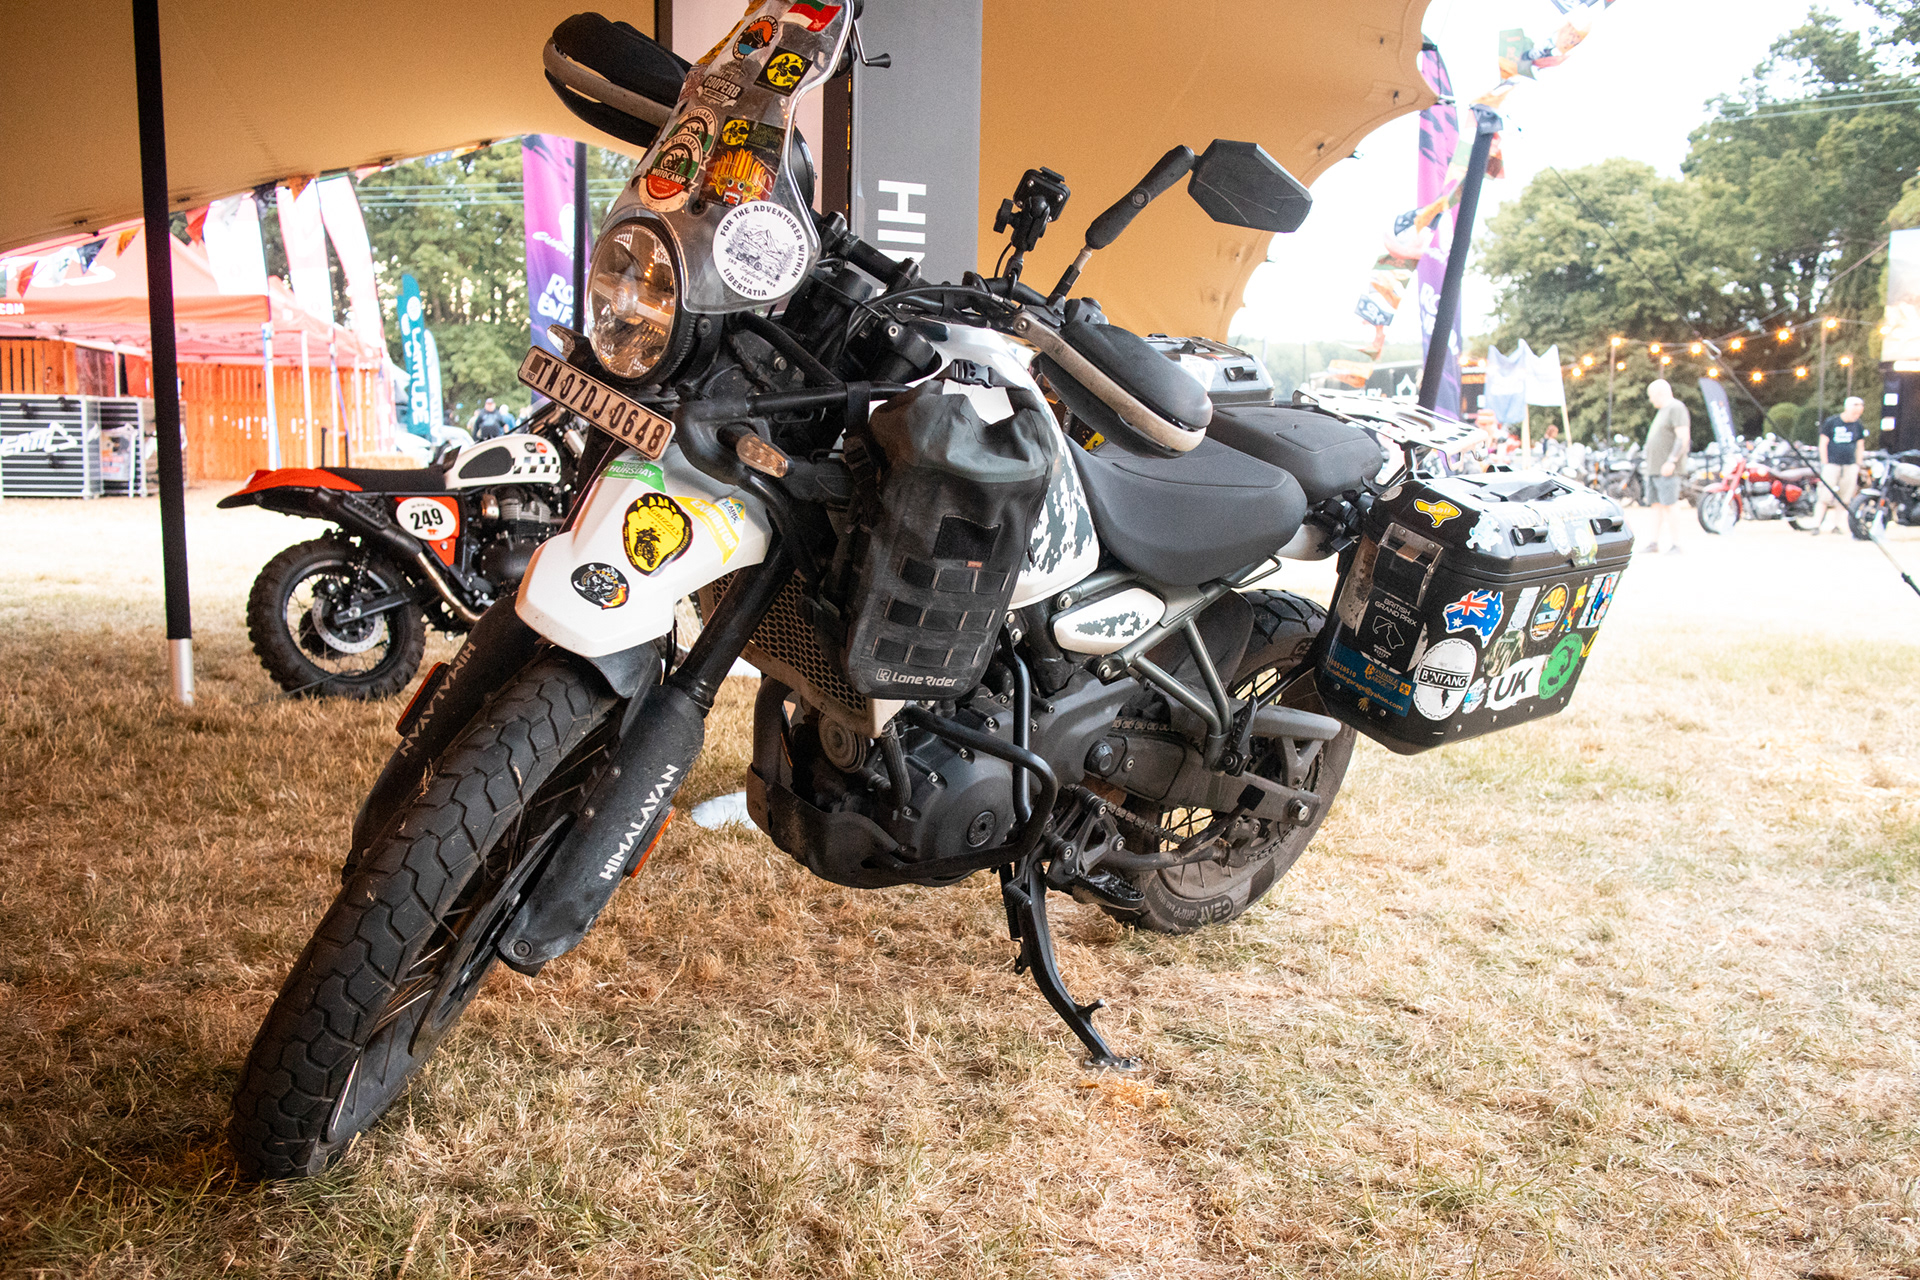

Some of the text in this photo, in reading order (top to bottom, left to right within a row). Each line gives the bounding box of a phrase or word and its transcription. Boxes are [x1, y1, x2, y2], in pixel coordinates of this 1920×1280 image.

[651, 167, 687, 185] MOTOCAMP
[720, 205, 805, 278] FOR THE ADVENTURER WITHIN
[723, 268, 768, 297] LIBERTATIA
[525, 372, 535, 381] IND
[605, 464, 656, 479] HURSDAY
[410, 507, 444, 531] 249
[650, 508, 683, 537] GRIZZLY
[691, 499, 737, 550] EXHIBITOR
[1374, 601, 1417, 627] GRAND PRIX
[1383, 598, 1411, 616] BRITISH
[892, 672, 923, 684] Lone
[925, 676, 958, 687] Rider
[1421, 669, 1468, 689] BNTANG
[1493, 666, 1534, 702] UK
[400, 642, 476, 757] HIMALAYAN
[600, 764, 679, 880] HIMALAYAN
[1173, 908, 1197, 921] GRIPP
